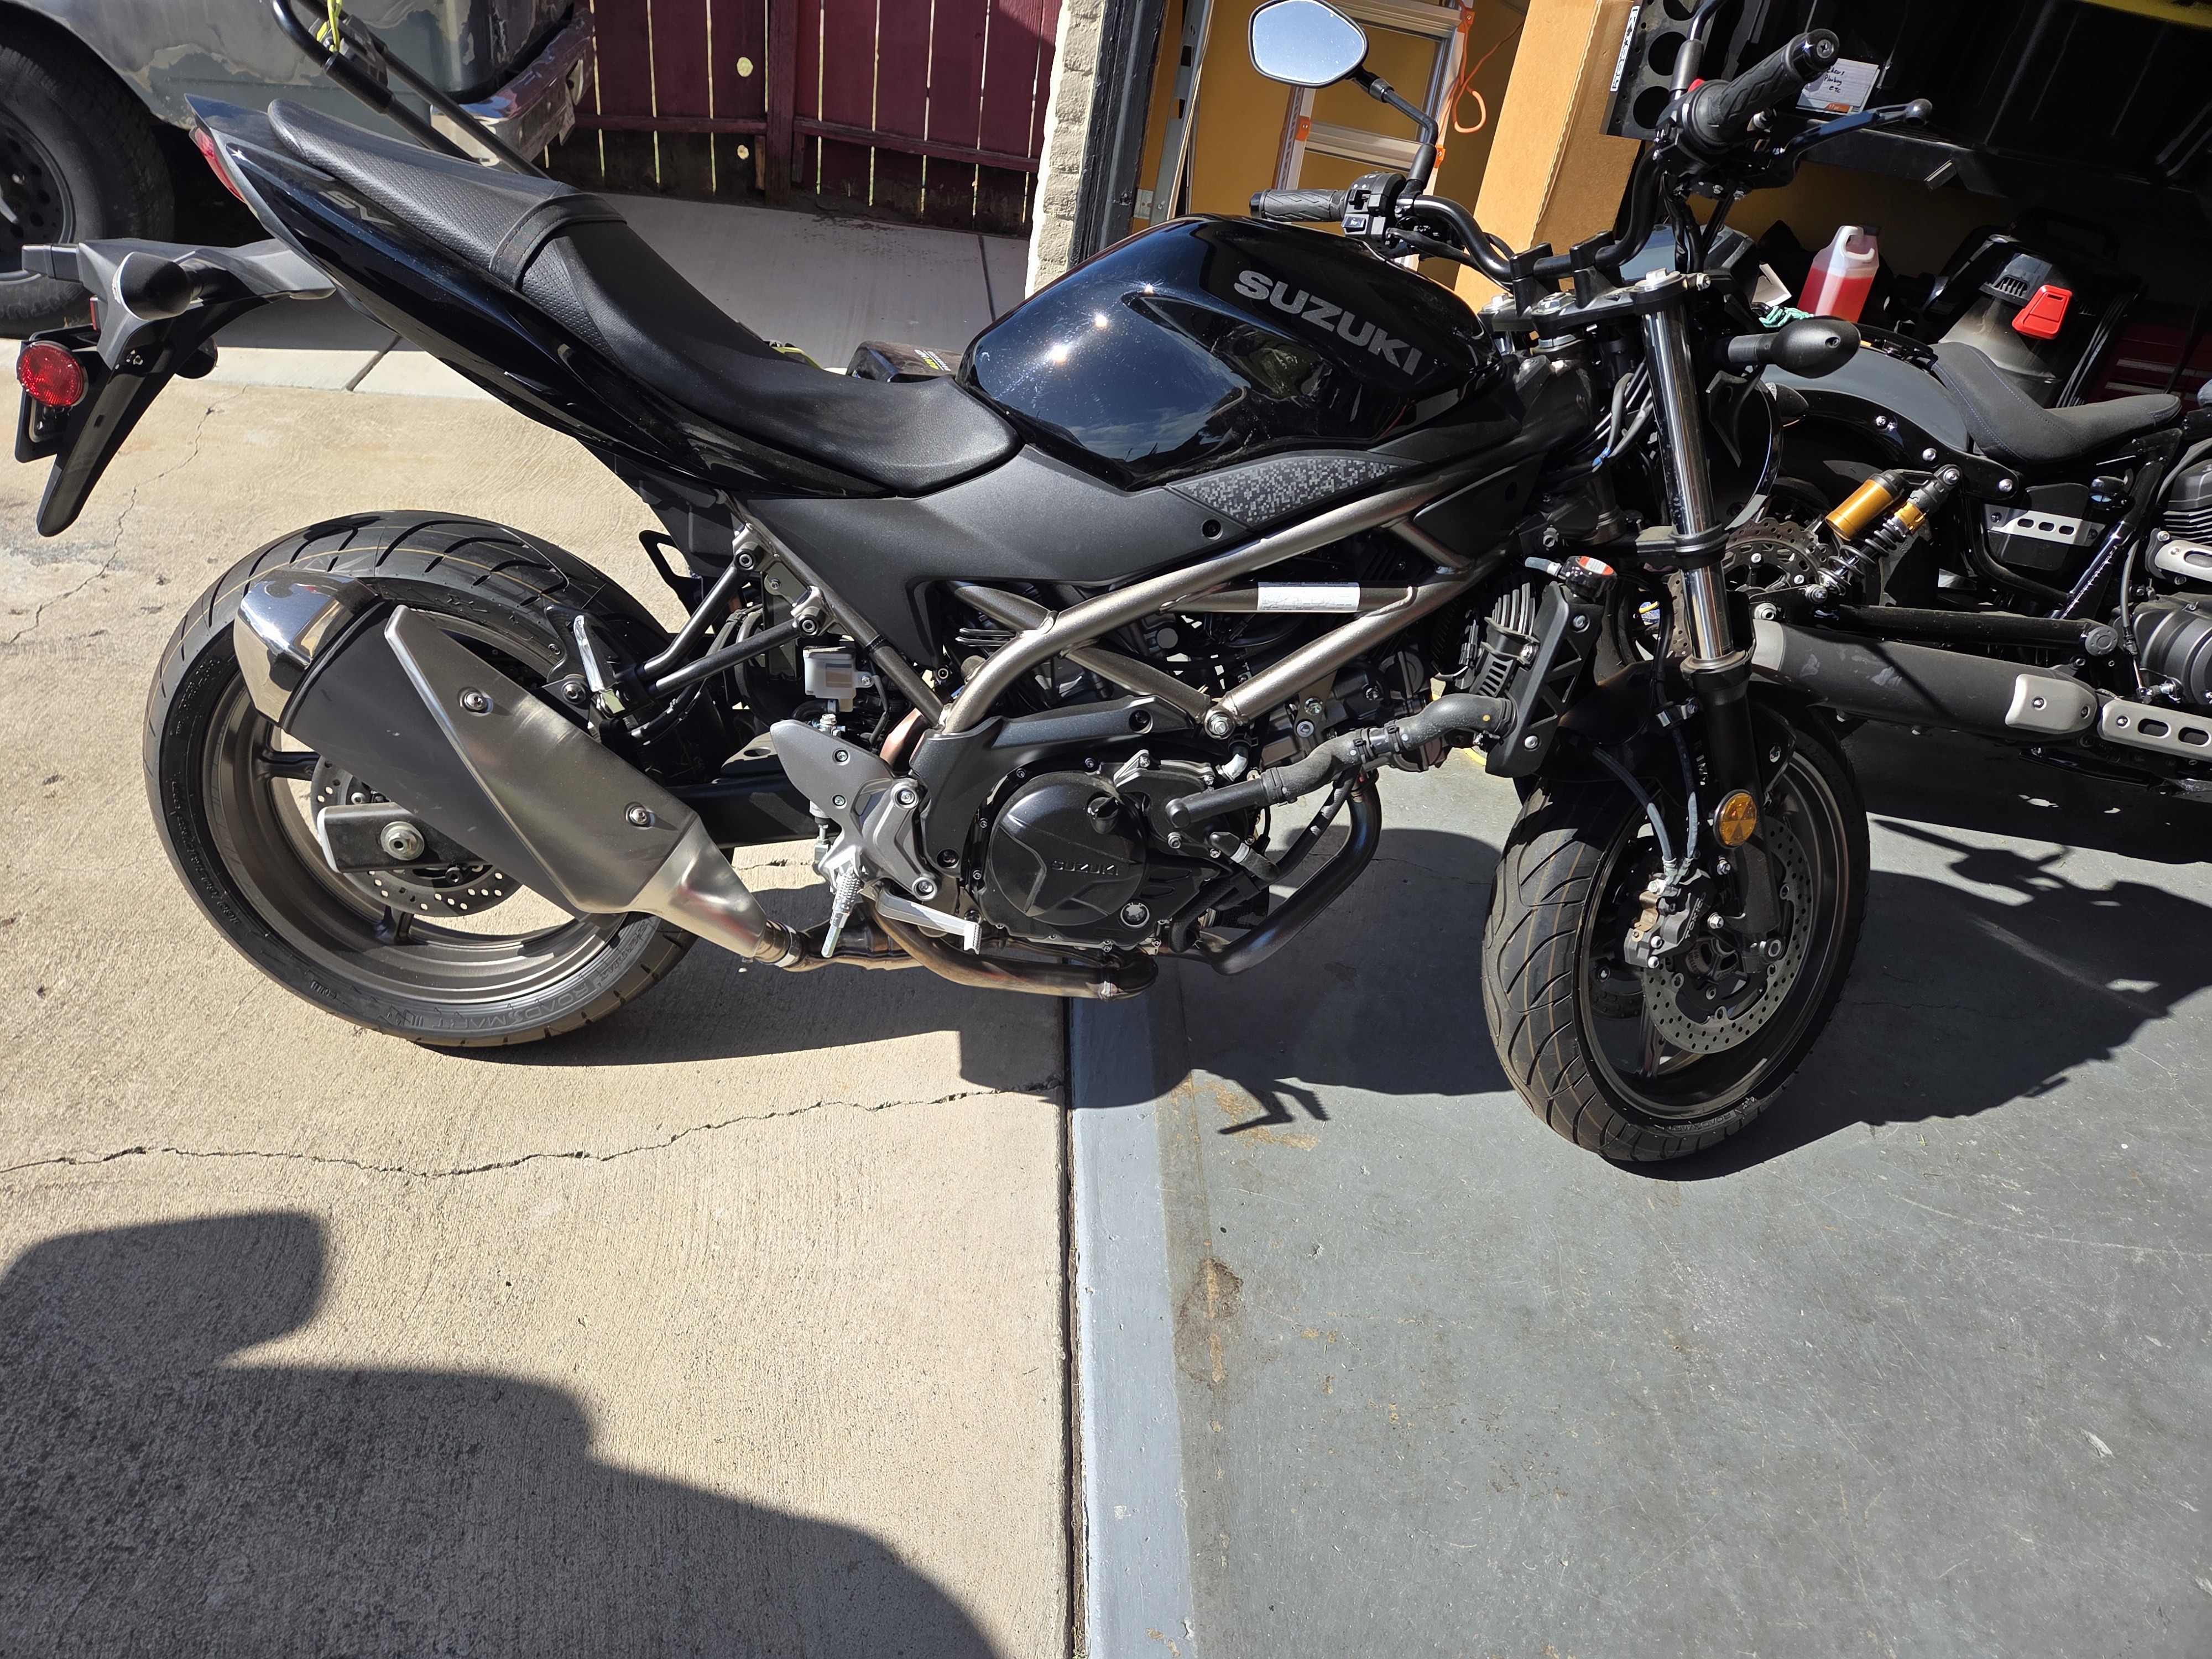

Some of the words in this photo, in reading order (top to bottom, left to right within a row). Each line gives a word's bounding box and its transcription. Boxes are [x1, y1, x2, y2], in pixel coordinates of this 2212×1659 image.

[1234, 270, 1422, 375] SUZUKI
[1051, 860, 1119, 876] SUZUKI
[1684, 892, 1707, 938] TOKICO
[430, 981, 595, 1029] ROADSMART
